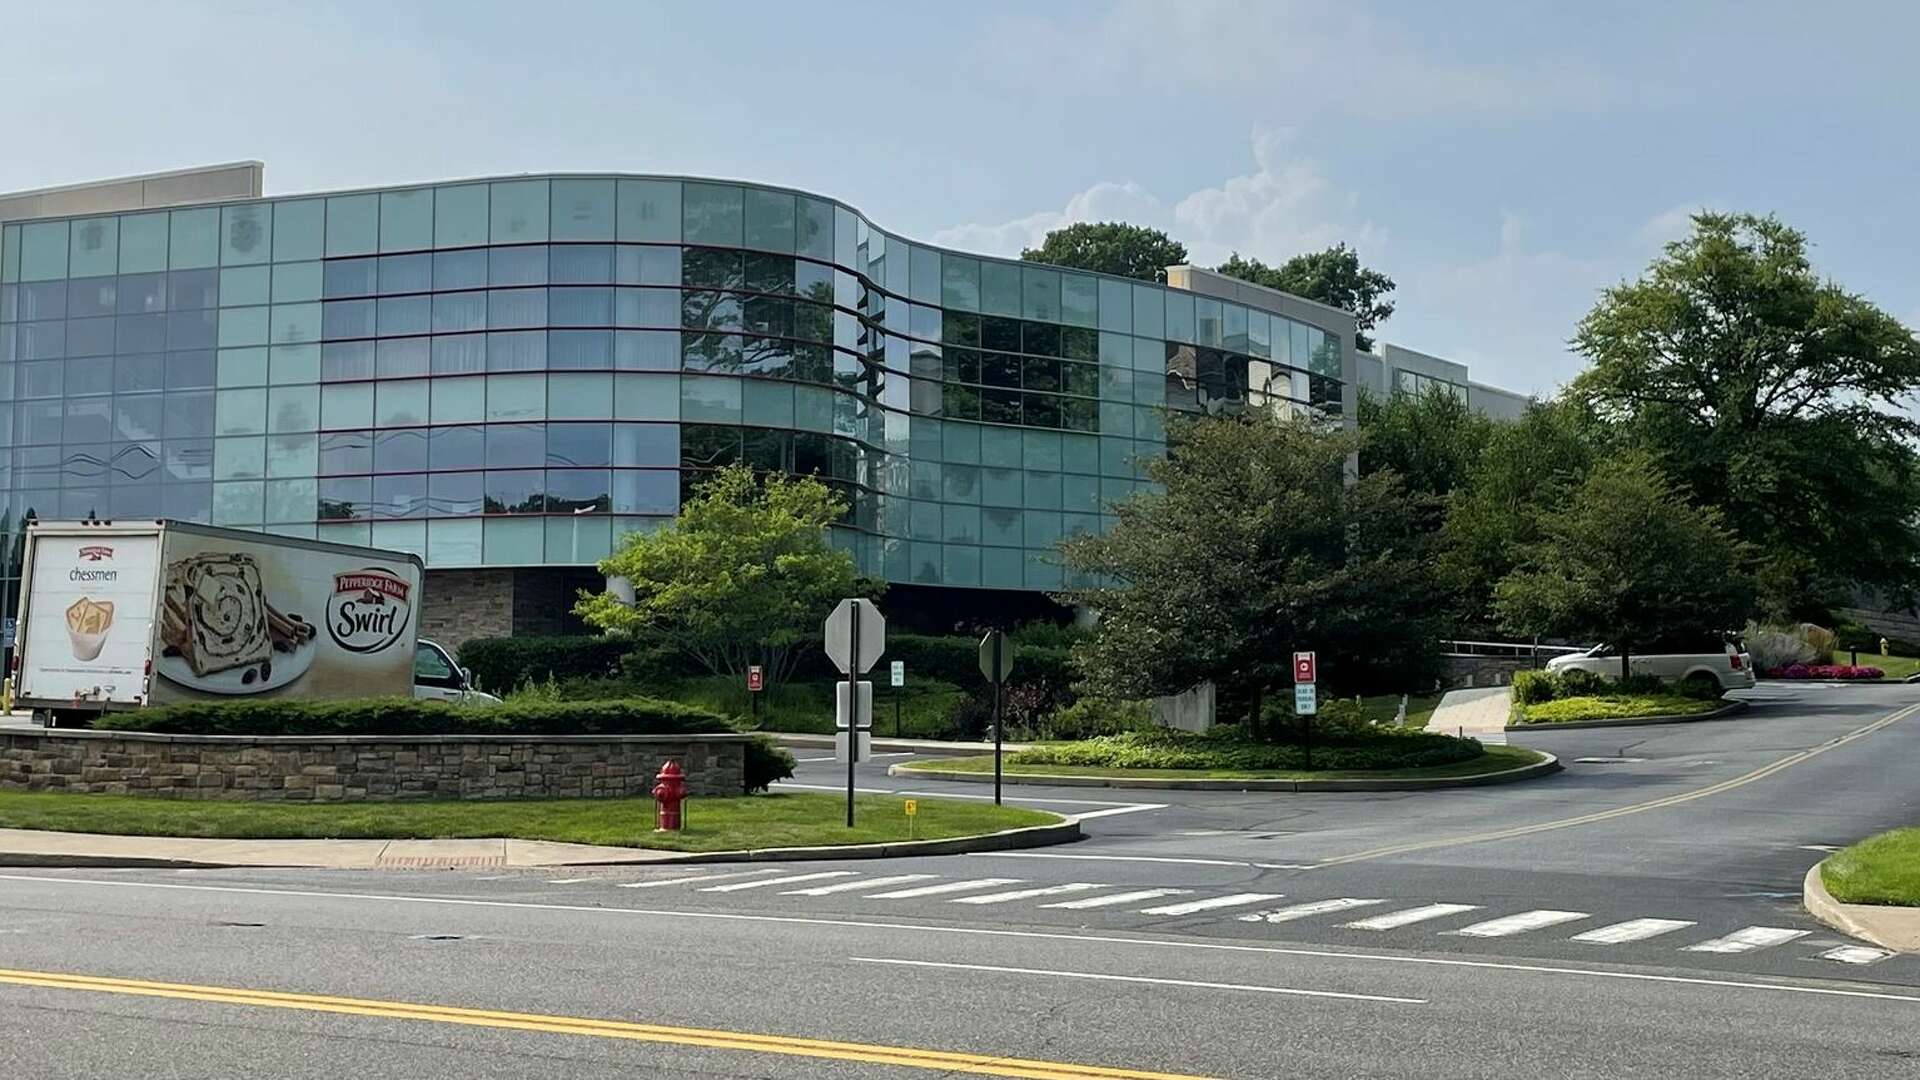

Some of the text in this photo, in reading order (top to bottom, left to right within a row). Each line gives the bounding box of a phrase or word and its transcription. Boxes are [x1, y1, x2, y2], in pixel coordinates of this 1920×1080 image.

[69, 567, 117, 581] chessmen
[384, 580, 405, 597] FARM
[337, 601, 397, 637] Swirl
